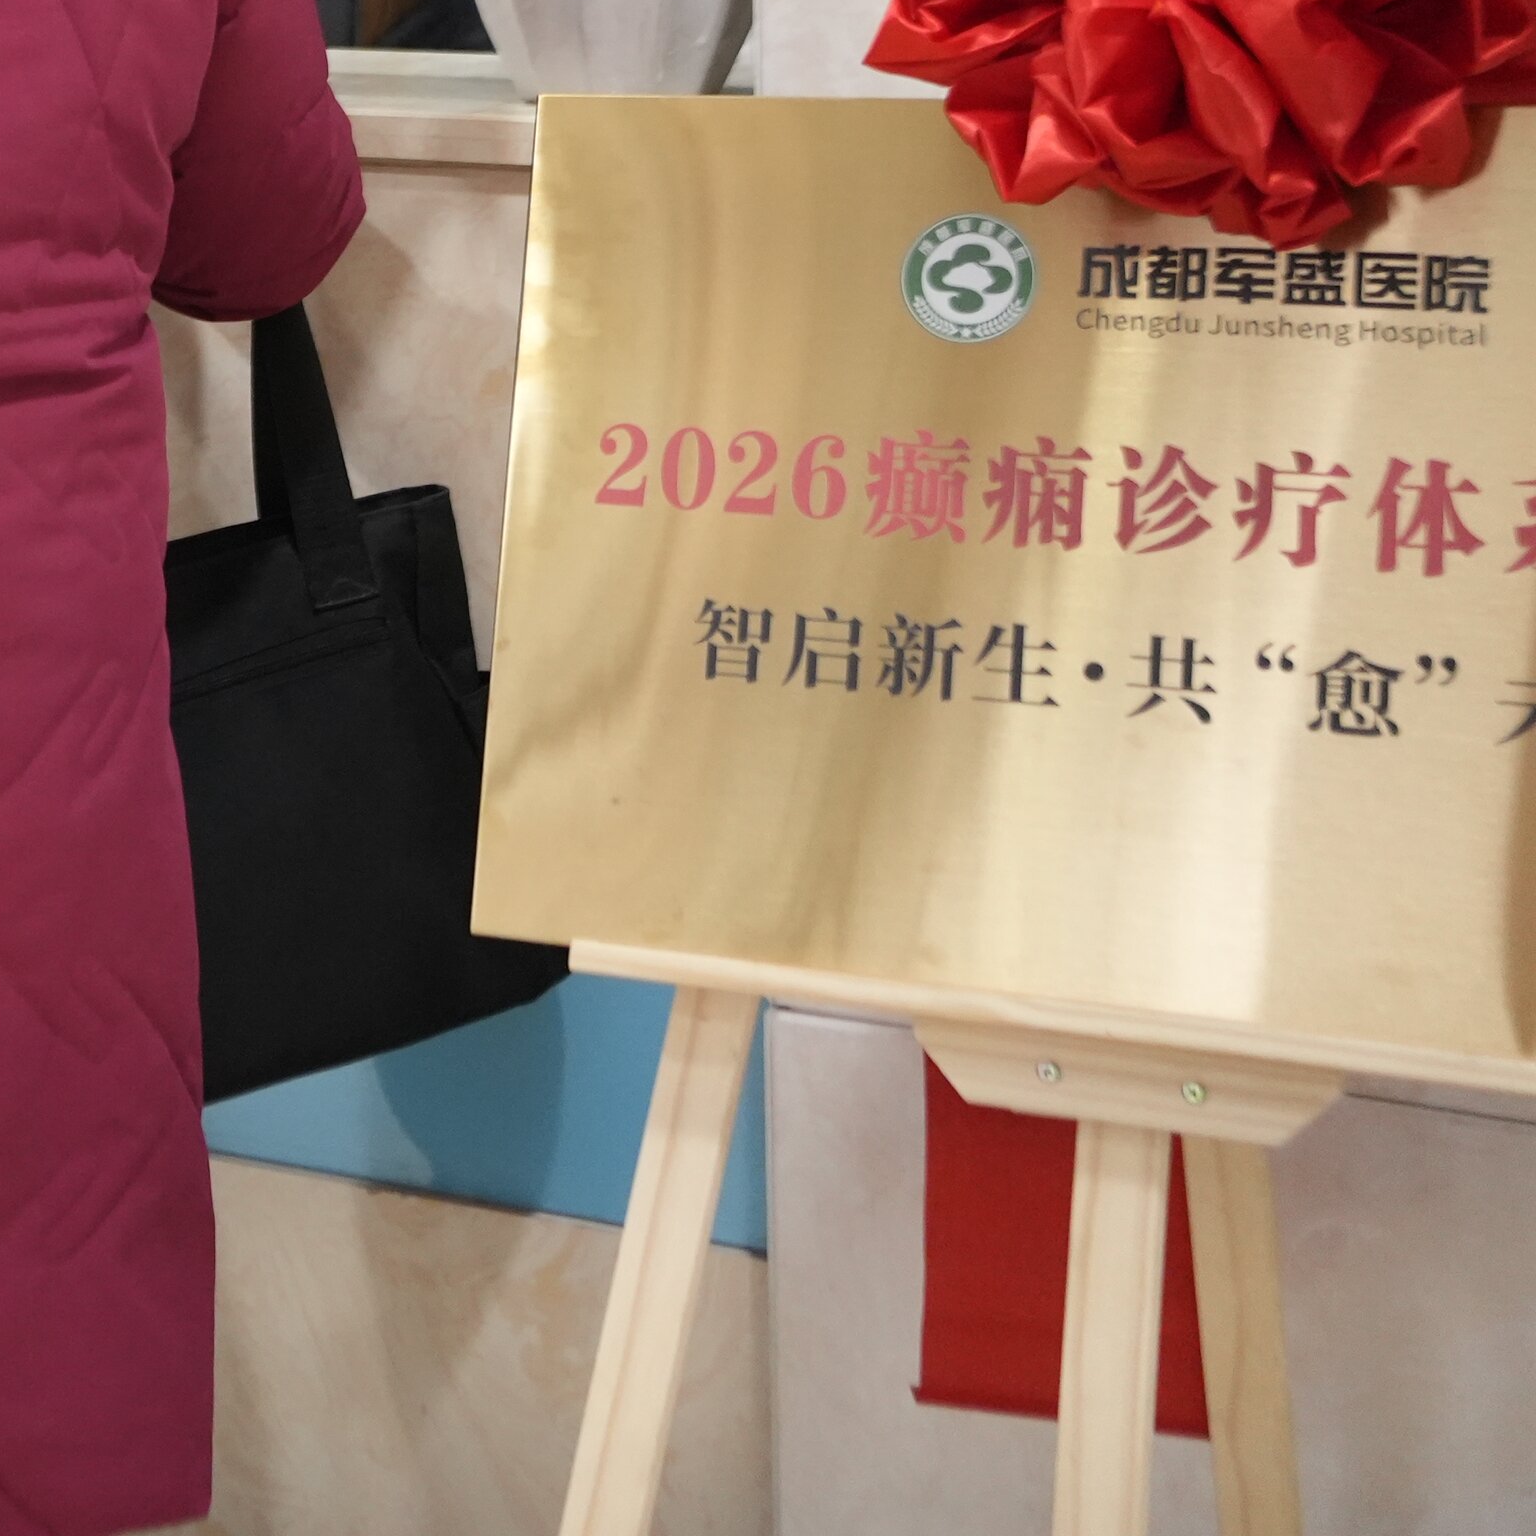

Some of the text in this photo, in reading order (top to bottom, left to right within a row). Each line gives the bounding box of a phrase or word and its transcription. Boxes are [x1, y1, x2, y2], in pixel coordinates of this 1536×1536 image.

[1077, 244, 1490, 314] 成都军盛医院
[1075, 308, 1487, 352] Chengdu Junsheng Hospital
[593, 421, 1536, 578] 2026癫痫诊疗体
